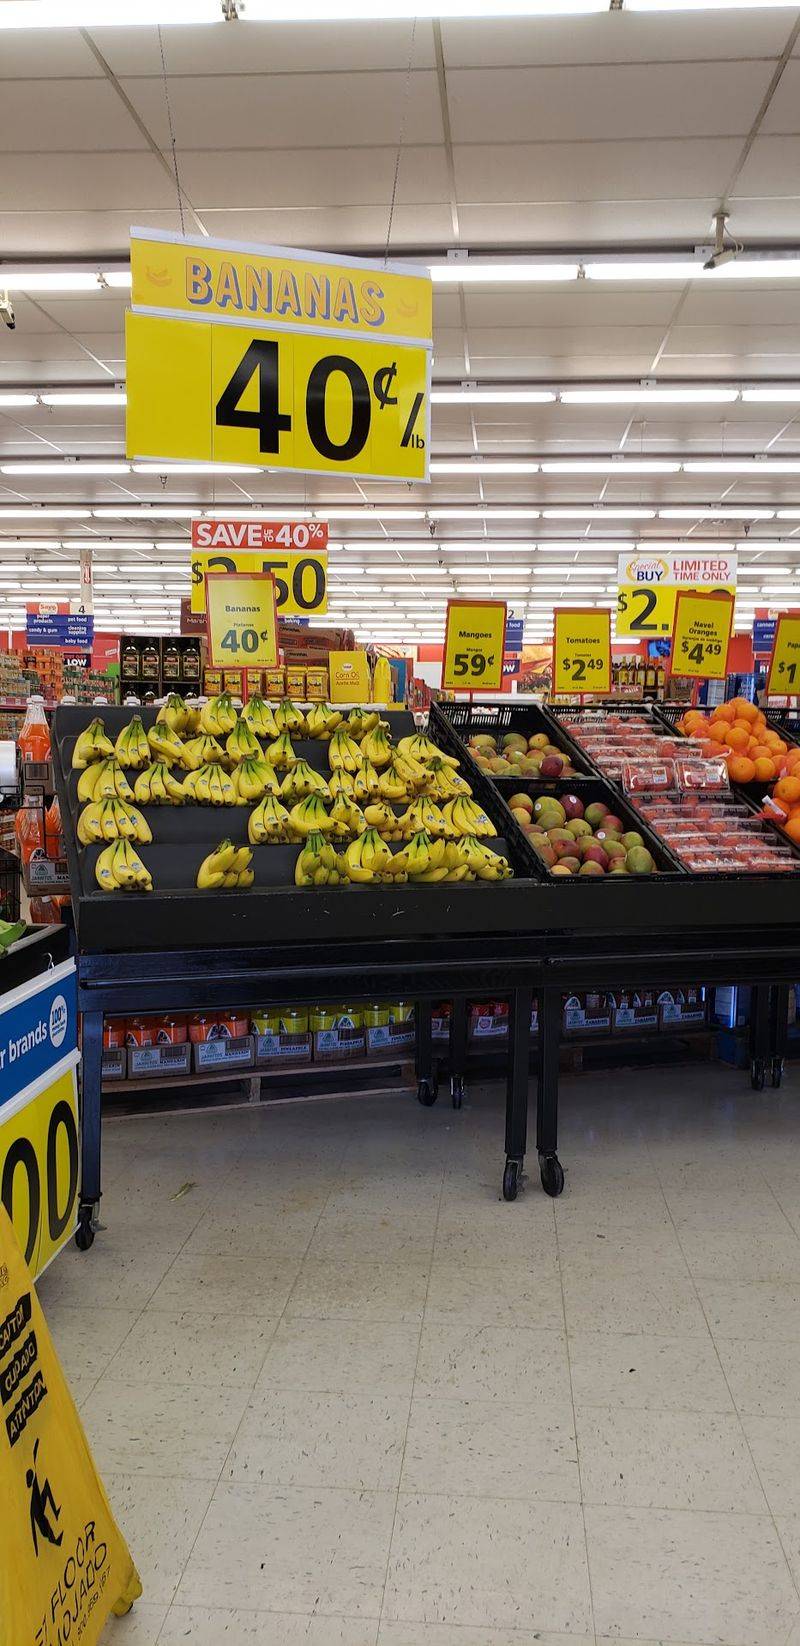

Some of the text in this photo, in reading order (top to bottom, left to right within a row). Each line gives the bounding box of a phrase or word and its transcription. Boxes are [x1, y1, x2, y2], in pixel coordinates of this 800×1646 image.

[185, 256, 385, 327] BANANAS
[196, 523, 263, 547] SAVE
[275, 523, 324, 548] 40%
[673, 560, 728, 571] LIMITED
[636, 571, 664, 581] BUY
[673, 572, 731, 581] TIME ONLY
[78, 605, 86, 614] 4
[508, 609, 515, 619] 2
[693, 620, 714, 629] Navel
[458, 630, 493, 639] Mangoes
[688, 627, 718, 637] Oranges
[221, 629, 268, 653] 40¢
[566, 636, 601, 644] Tomatoes
[66, 658, 87, 667] LOW
[453, 653, 495, 677] 59¢
[8, 1020, 48, 1063] brands
[50, 1520, 96, 1624] FLOOR
